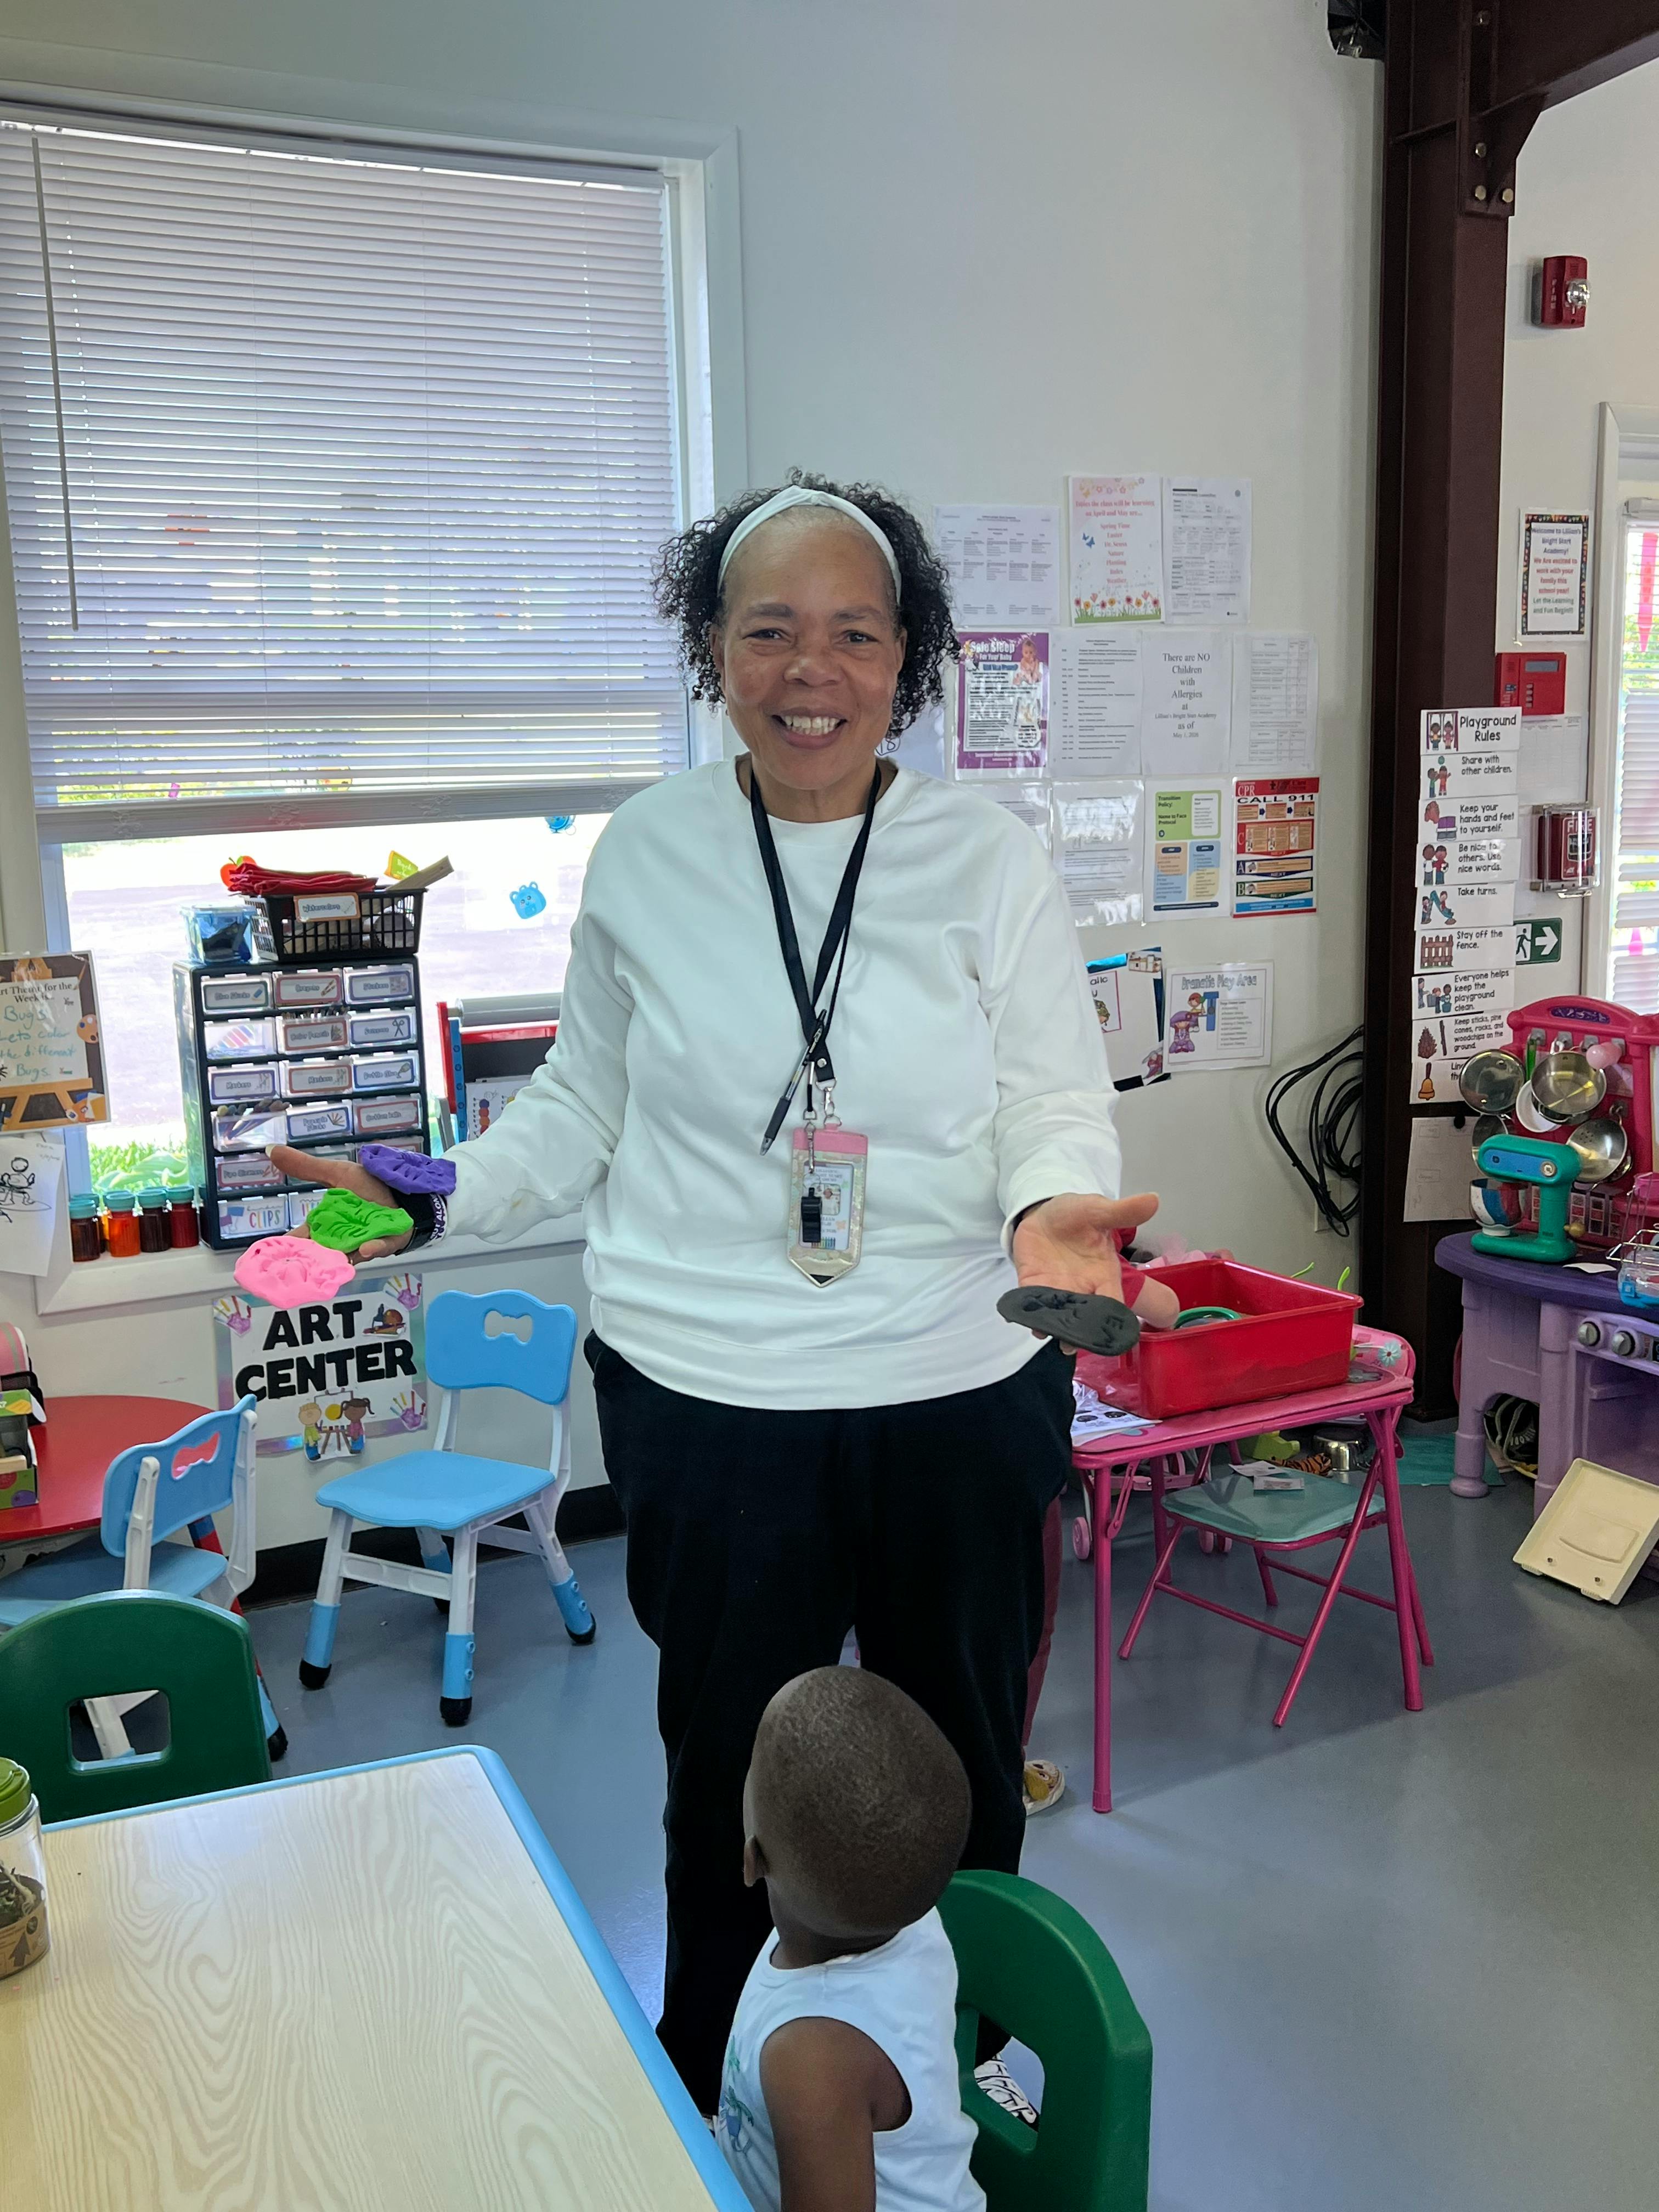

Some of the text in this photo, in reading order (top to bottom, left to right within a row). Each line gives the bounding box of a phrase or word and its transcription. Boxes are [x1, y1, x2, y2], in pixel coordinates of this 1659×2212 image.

[1541, 577, 1556, 585] family
[991, 640, 1015, 654] Sleep
[1163, 653, 1183, 662] There
[1198, 653, 1210, 662] NO
[1172, 665, 1202, 674] Children
[1180, 678, 1195, 686] with
[1171, 690, 1203, 700] Allergies
[1187, 721, 1195, 729] of
[1460, 714, 1517, 729] Playground
[1475, 730, 1500, 742] Rules
[1462, 755, 1499, 765] Share with
[1462, 764, 1512, 775] other children.
[1238, 785, 1255, 796] CPR
[1460, 803, 1498, 814] Keep your
[1459, 811, 1514, 823] hands and feet
[1460, 823, 1503, 836] to yourself.
[1238, 833, 1244, 845] C
[1459, 843, 1468, 852] Be
[1470, 843, 1486, 851] nice
[1458, 854, 1485, 863] others.
[1238, 862, 1245, 874] A
[1458, 862, 1502, 873] nice words.
[1238, 883, 1245, 896] B
[1458, 887, 1498, 896] Take turns.
[302, 902, 341, 913] Watercolors
[1457, 929, 1503, 941] Stay off the
[1457, 941, 1480, 950] fence.
[1454, 969, 1509, 983] Everyone helps
[44, 983, 57, 991] for
[363, 981, 390, 991] Stickers
[1181, 974, 1257, 991] Dramatic Play Area
[1454, 982, 1486, 993] keep the
[295, 984, 320, 992] Crayons
[14, 995, 40, 1003] Week
[215, 992, 229, 1001] Glue
[1454, 990, 1495, 1004] playground
[4, 1006, 47, 1030] Bugs
[1494, 1021, 1503, 1029] and
[38, 1027, 70, 1039] color
[308, 1030, 329, 1040] Pencils
[1454, 1034, 1485, 1042] woodchips
[24, 1044, 76, 1057] different
[308, 1075, 333, 1084] Markers
[363, 1070, 398, 1080] Bottle Glue
[1451, 1071, 1459, 1080] th
[226, 1081, 251, 1090] Markers
[366, 1113, 388, 1122] Cotton
[223, 1170, 237, 1178] Pipe
[249, 1209, 281, 1229] CLIPS
[262, 1300, 363, 1351] ART
[235, 1339, 417, 1403] CENTER
